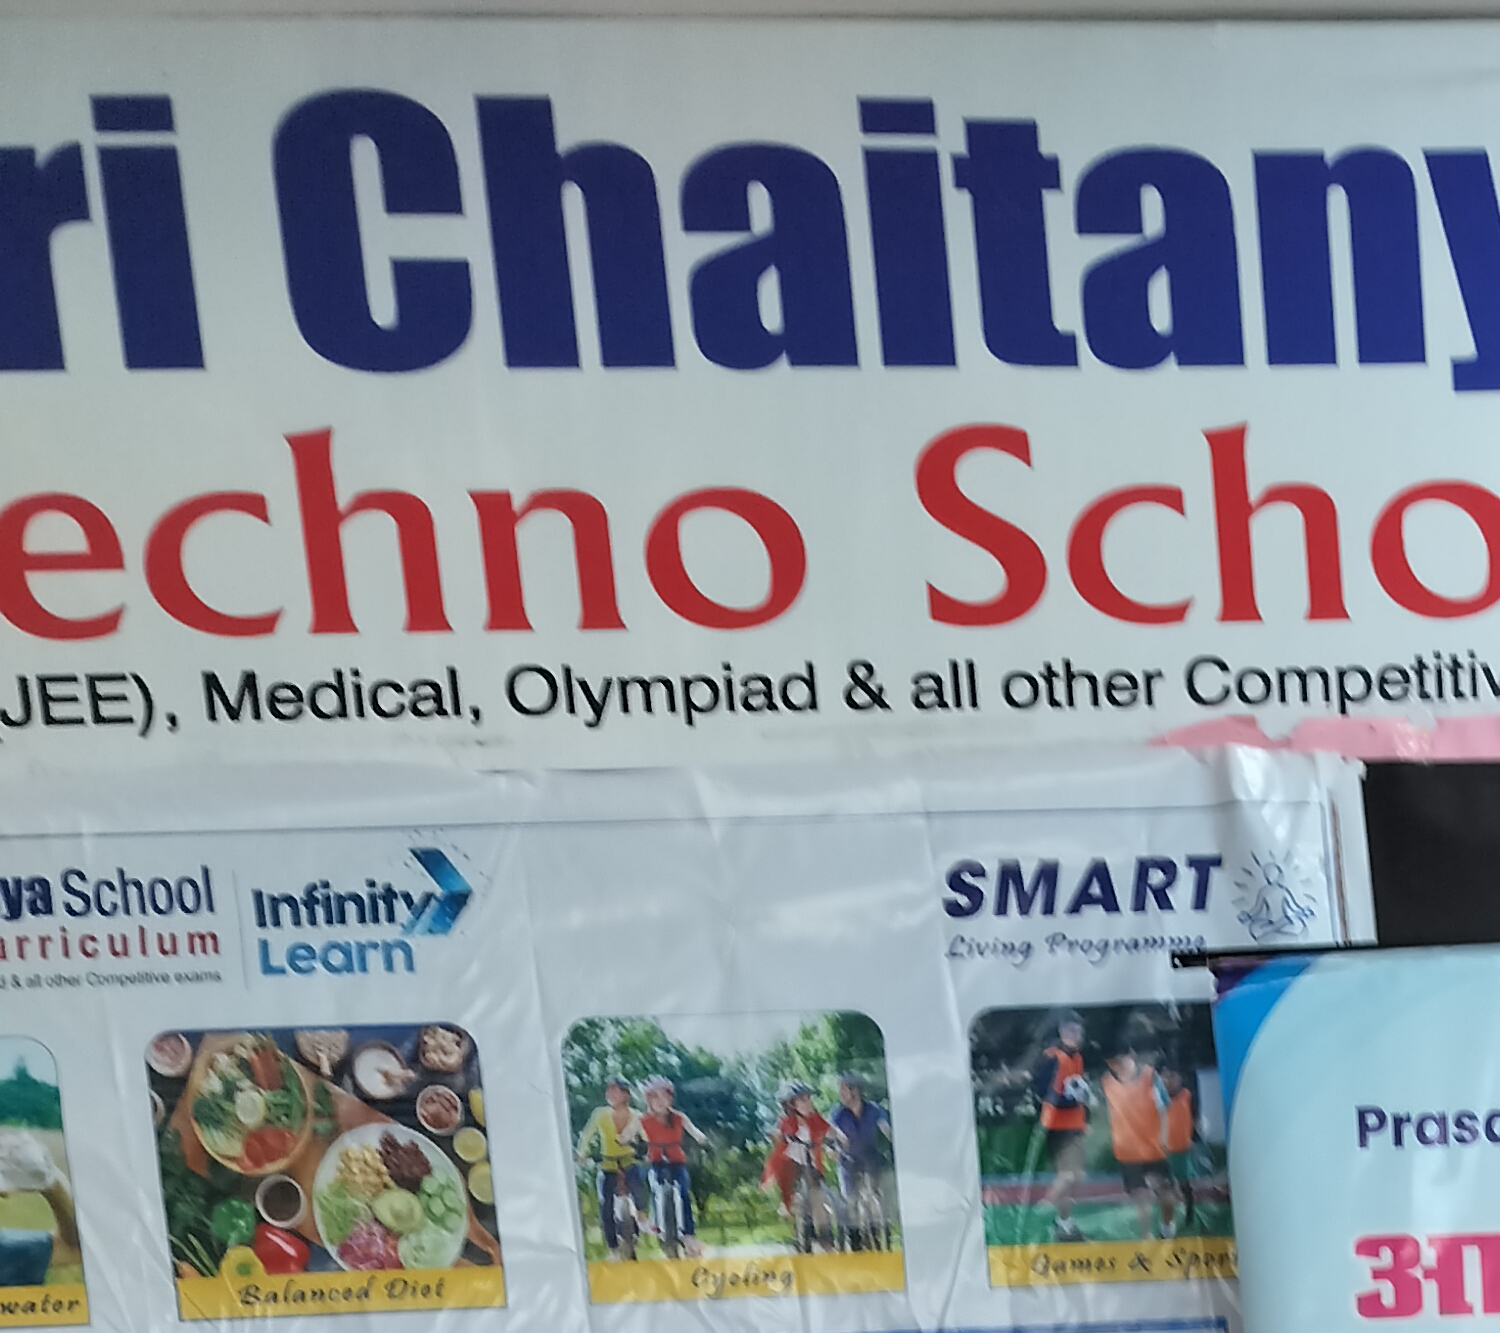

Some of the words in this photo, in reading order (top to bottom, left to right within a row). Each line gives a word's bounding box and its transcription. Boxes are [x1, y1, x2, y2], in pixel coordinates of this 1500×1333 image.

[0, 94, 205, 372] ri
[0, 427, 628, 642] echno
[0, 671, 179, 740] JEE),
[201, 664, 484, 727] Medical,
[504, 659, 818, 725] Olympiad
[841, 661, 892, 714] &
[910, 659, 980, 712] all
[1002, 658, 1163, 713] other
[60, 864, 216, 918] School
[251, 876, 436, 935] Infinity
[942, 853, 1223, 919] SMART
[258, 936, 417, 978] Learn
[945, 933, 1032, 969] Living
[1044, 931, 1206, 969] Programme
[45, 970, 82, 988] other
[86, 969, 171, 988] Competitive
[174, 967, 222, 984] exams
[690, 1259, 795, 1300] Cycling
[1031, 1250, 1117, 1276] Games
[238, 1279, 377, 1306] Balanced
[384, 1276, 445, 1300] Diet
